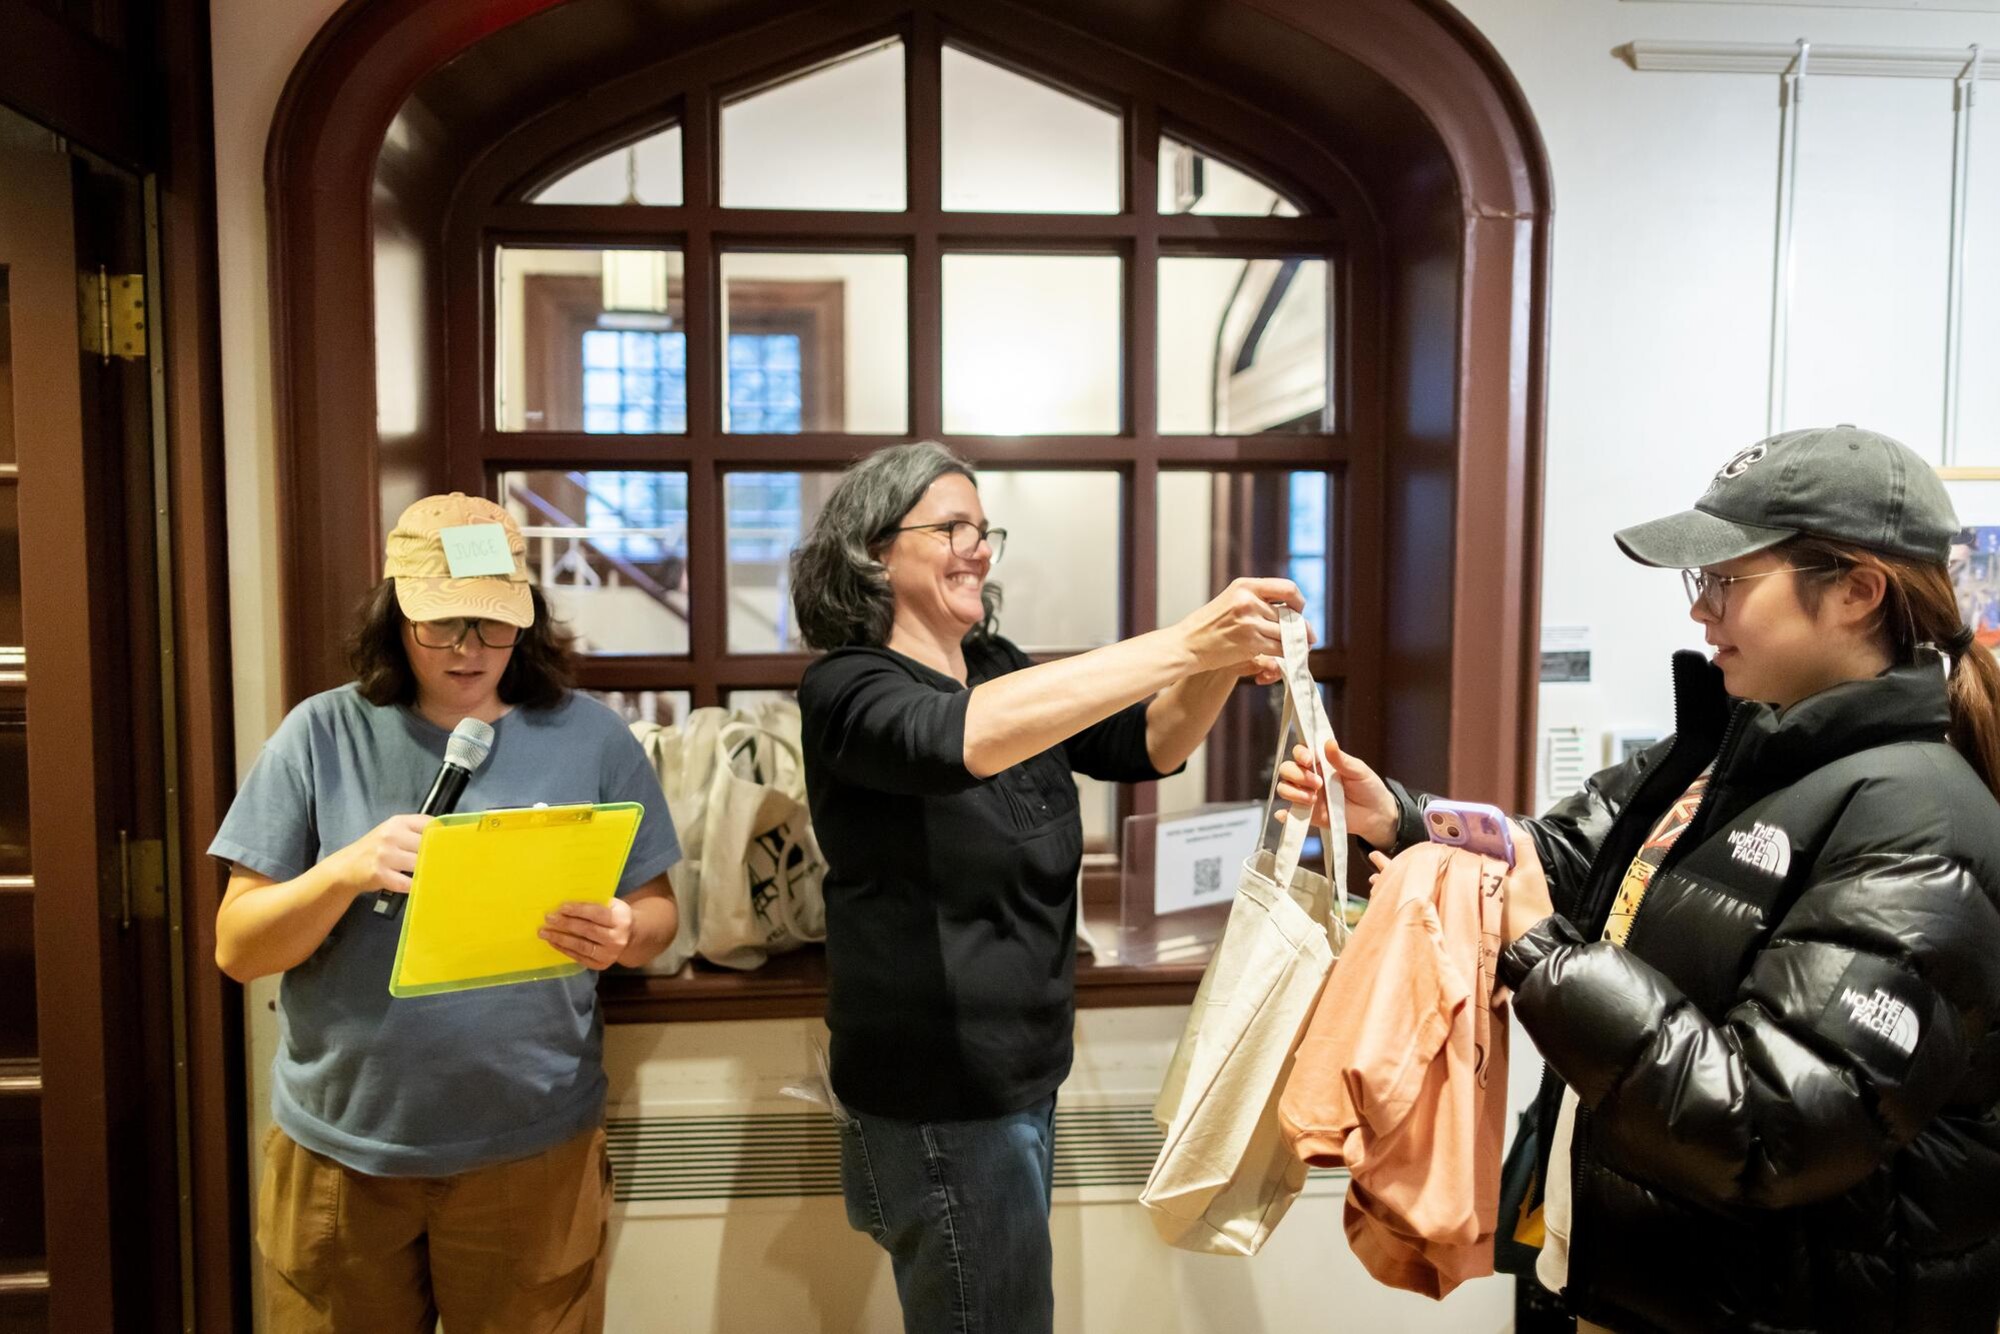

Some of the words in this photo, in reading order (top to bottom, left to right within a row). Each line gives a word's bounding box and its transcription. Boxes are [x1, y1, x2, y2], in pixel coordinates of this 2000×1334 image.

[452, 538, 498, 561] JUDGE
[1727, 830, 1769, 854] NORTH
[1752, 821, 1776, 841] THE
[1731, 845, 1763, 867] FACE
[1840, 987, 1900, 1028] NORTH
[1874, 988, 1905, 1015] THE
[1849, 1006, 1895, 1038] FACE
